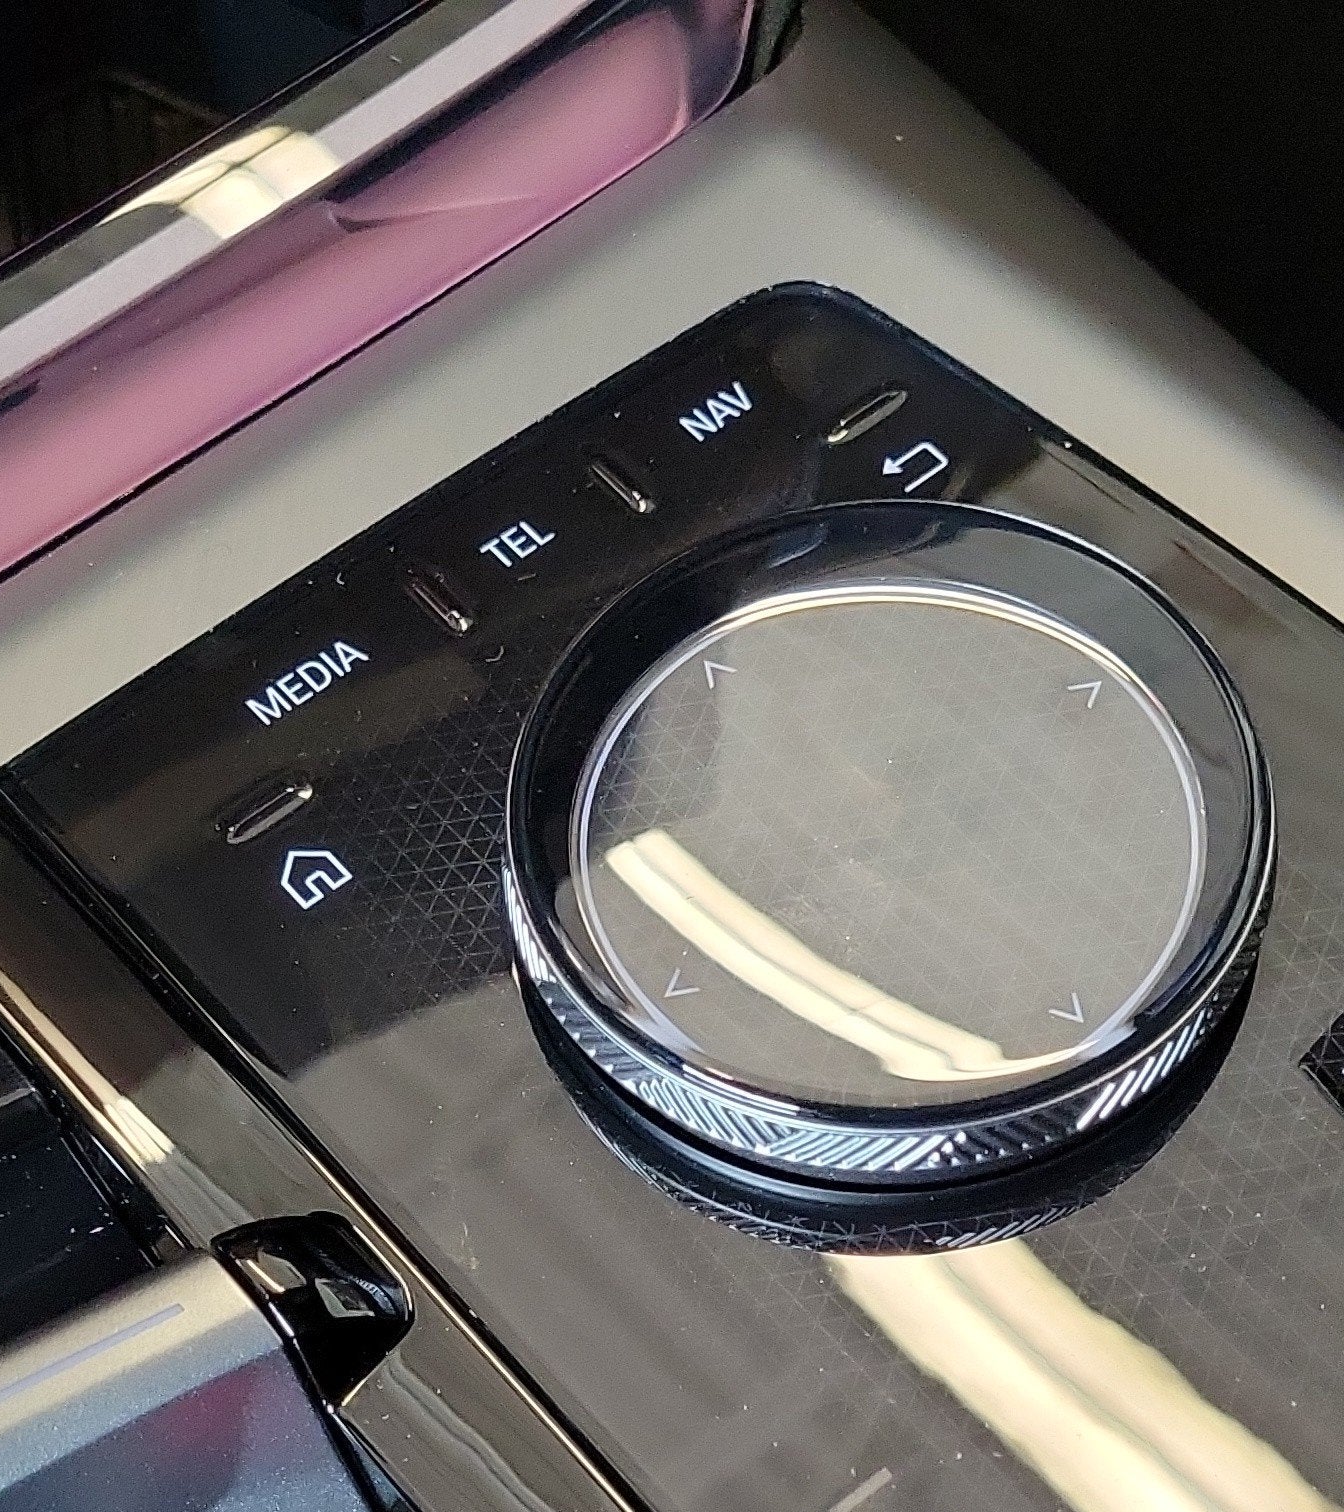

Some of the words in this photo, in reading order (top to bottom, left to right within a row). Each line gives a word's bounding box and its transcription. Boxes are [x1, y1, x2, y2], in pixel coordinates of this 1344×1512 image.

[677, 381, 755, 443] NAV
[479, 519, 556, 570] TEL
[244, 640, 369, 726] MEDIA
